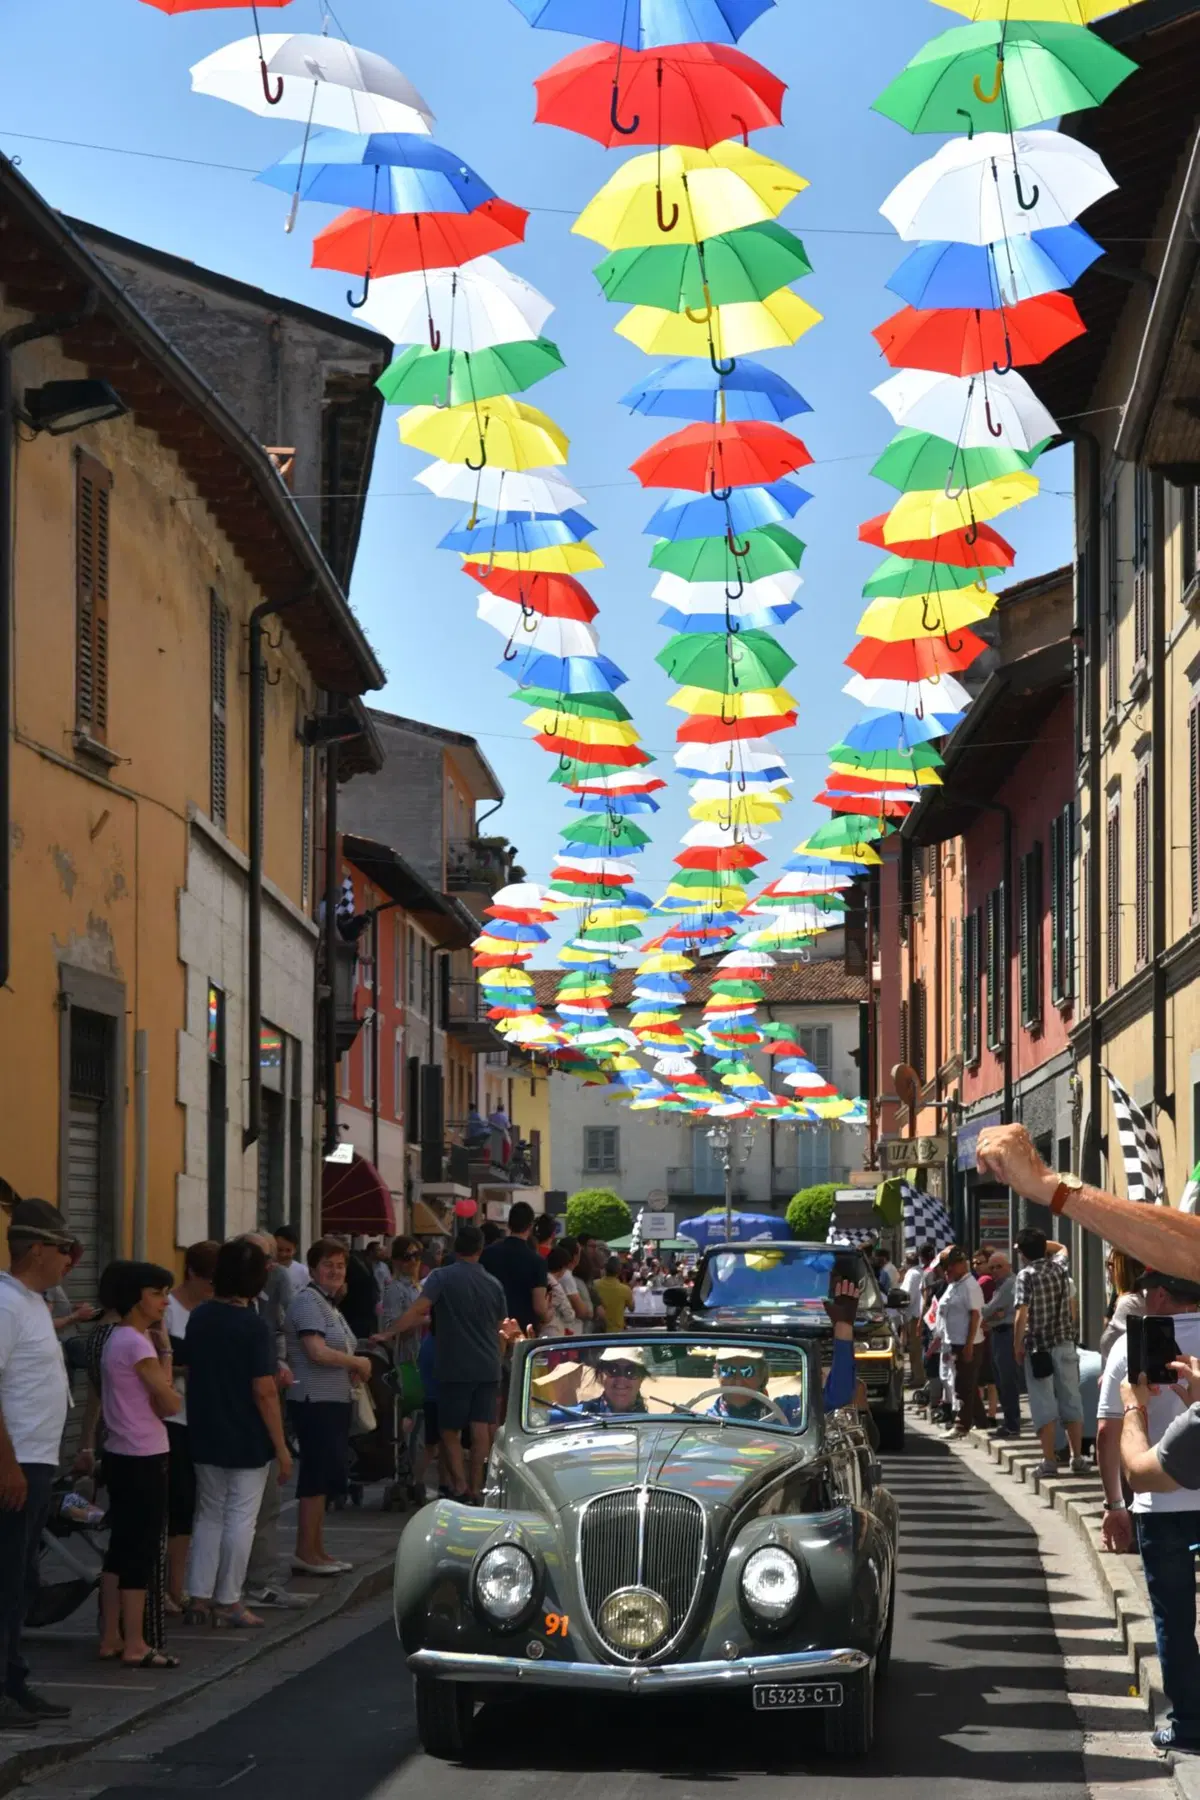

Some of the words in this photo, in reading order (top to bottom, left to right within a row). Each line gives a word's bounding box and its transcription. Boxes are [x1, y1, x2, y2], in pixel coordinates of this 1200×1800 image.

[545, 1612, 569, 1637] 91
[760, 1688, 805, 1704] 15323
[813, 1687, 835, 1703] CT
